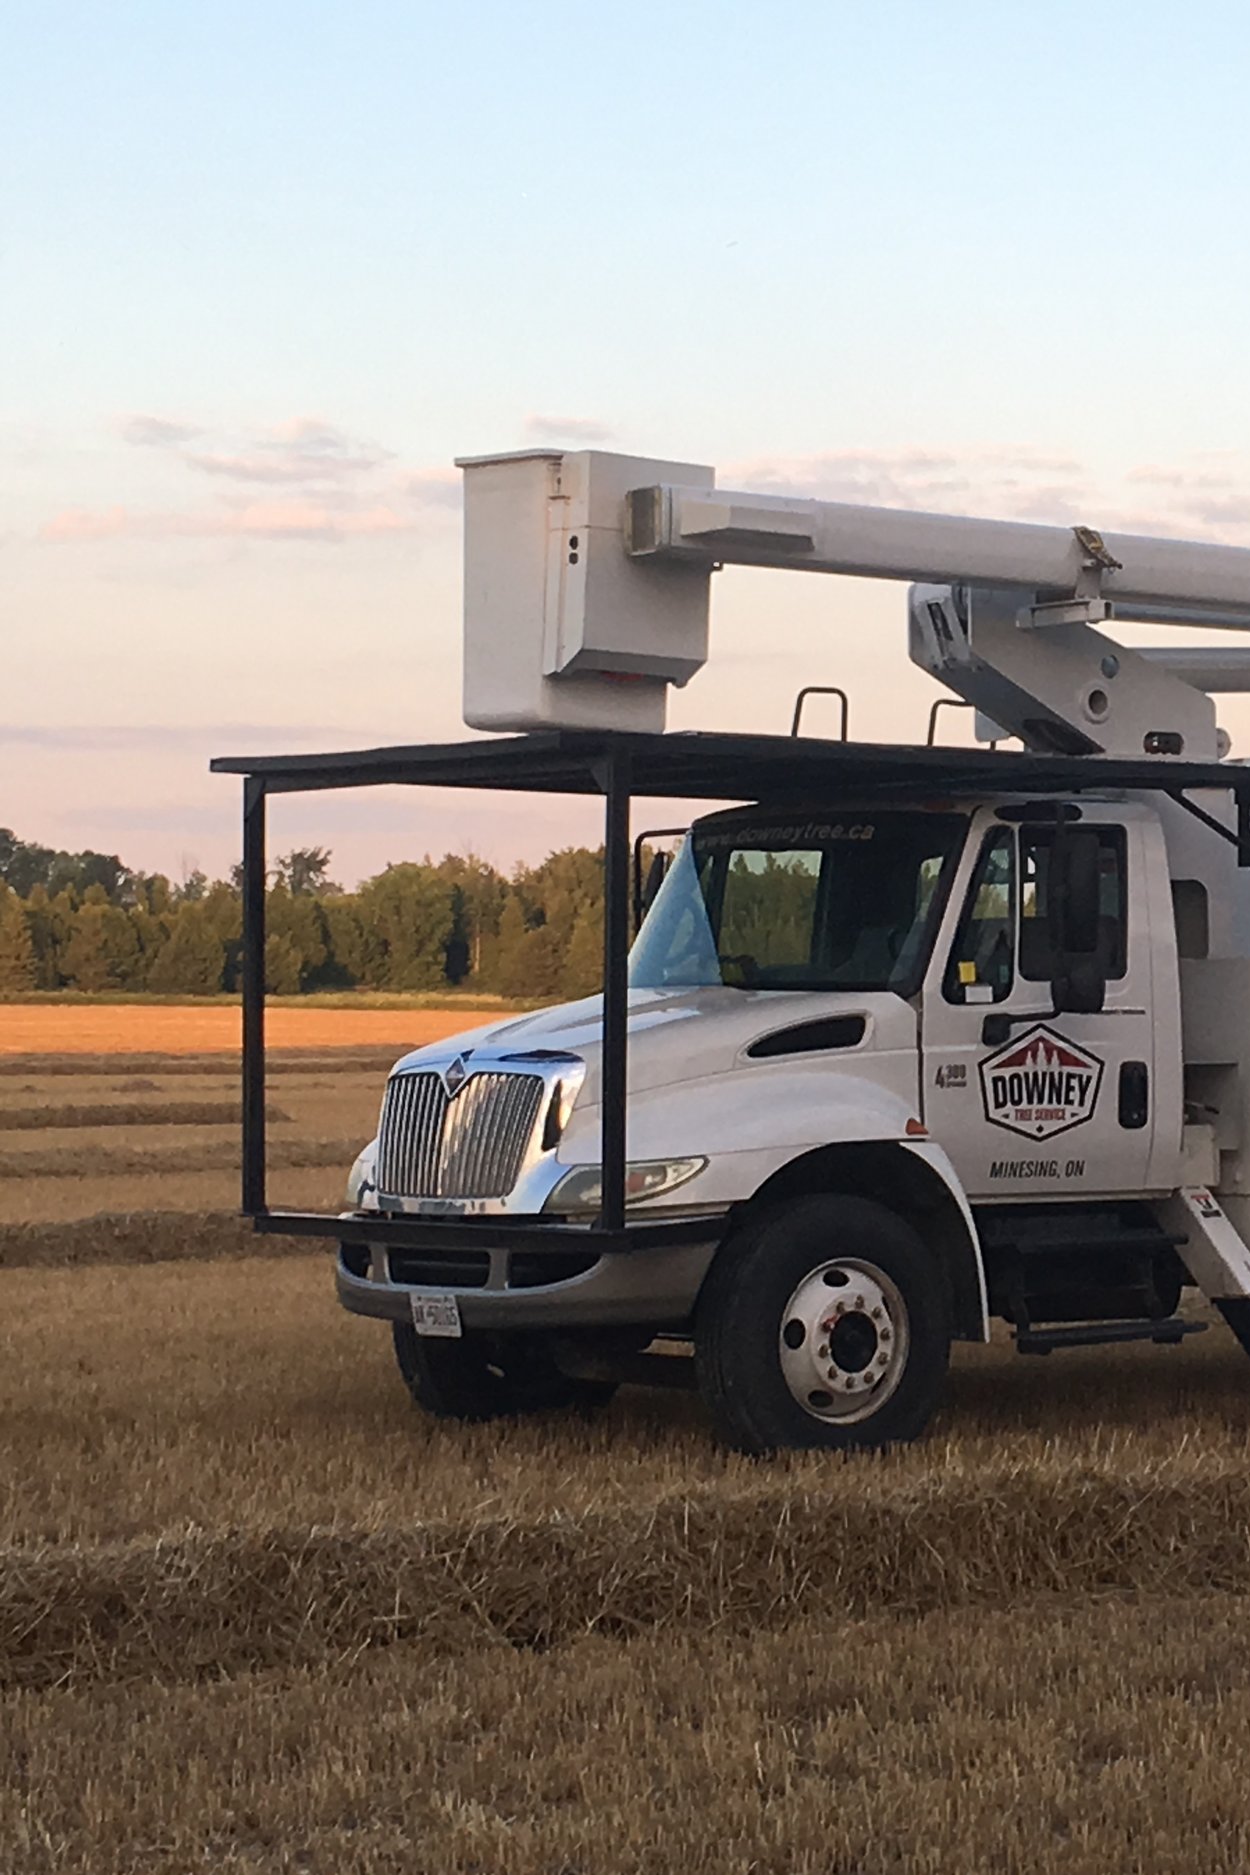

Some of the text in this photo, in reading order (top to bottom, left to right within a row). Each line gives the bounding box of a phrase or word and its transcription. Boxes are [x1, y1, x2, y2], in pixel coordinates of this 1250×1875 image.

[992, 1071, 1093, 1109] DOWNEY
[1015, 1108, 1066, 1121] TREE SERVICE
[990, 1160, 1085, 1179] MINESING, ON
